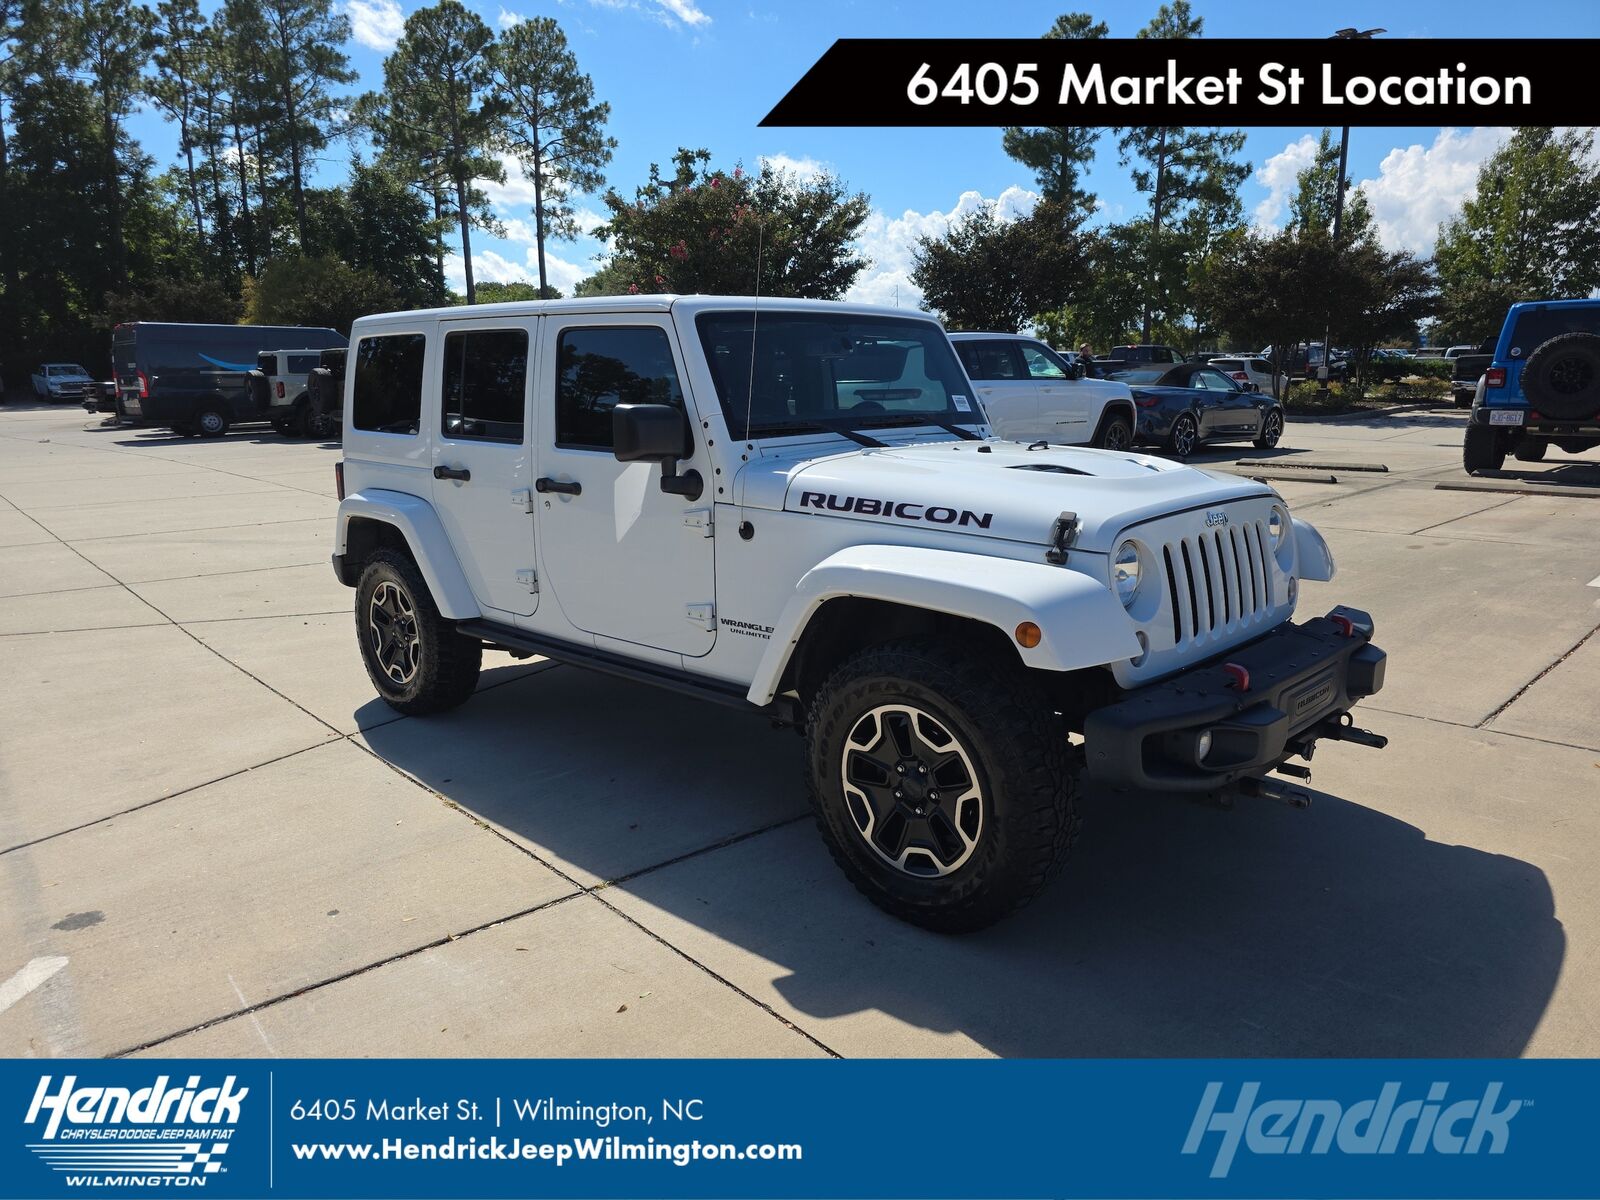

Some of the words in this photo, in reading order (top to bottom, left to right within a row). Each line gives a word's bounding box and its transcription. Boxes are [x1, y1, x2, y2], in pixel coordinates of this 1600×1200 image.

[800, 491, 994, 529] RUBICON
[1205, 511, 1229, 527] Jeep
[1297, 686, 1330, 709] RUBICON
